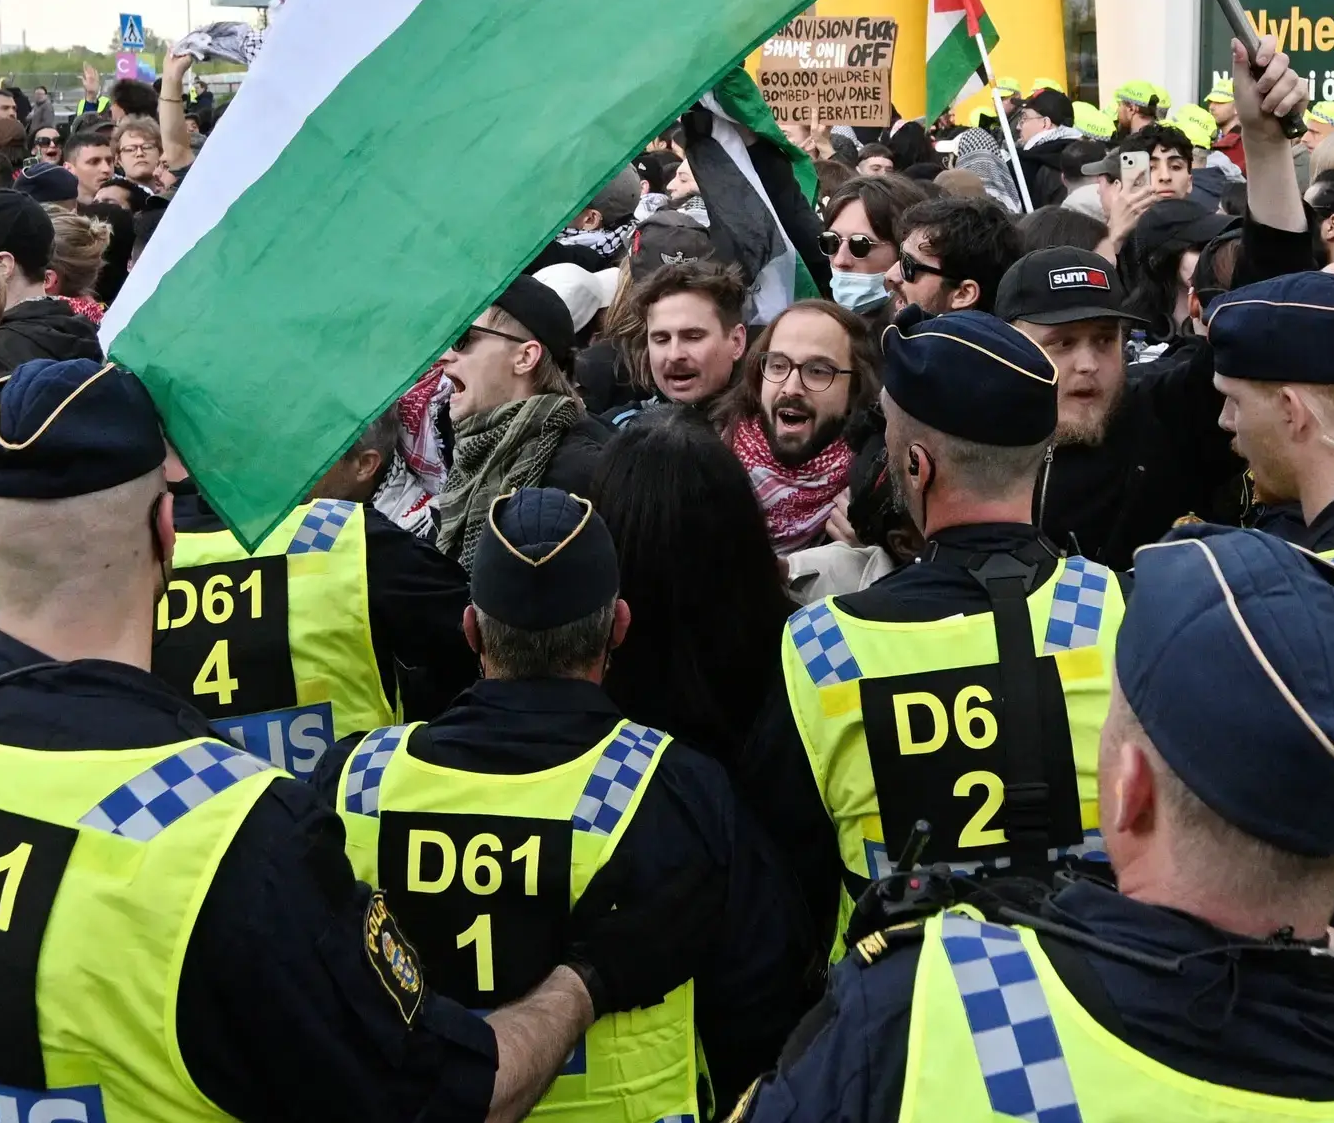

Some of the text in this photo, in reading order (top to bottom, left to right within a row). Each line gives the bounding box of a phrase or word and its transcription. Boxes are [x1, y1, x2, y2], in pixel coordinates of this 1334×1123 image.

[763, 39, 834, 58] SHAME ON
[777, 17, 895, 40] ROVISION FUCK
[848, 42, 891, 67] OFF
[822, 70, 882, 85] CHILDREN
[849, 87, 881, 101] DARE
[157, 569, 262, 630] D61
[193, 639, 239, 705] 4
[953, 770, 1010, 848] 2
[407, 829, 541, 896] D61
[456, 914, 494, 991] 1
